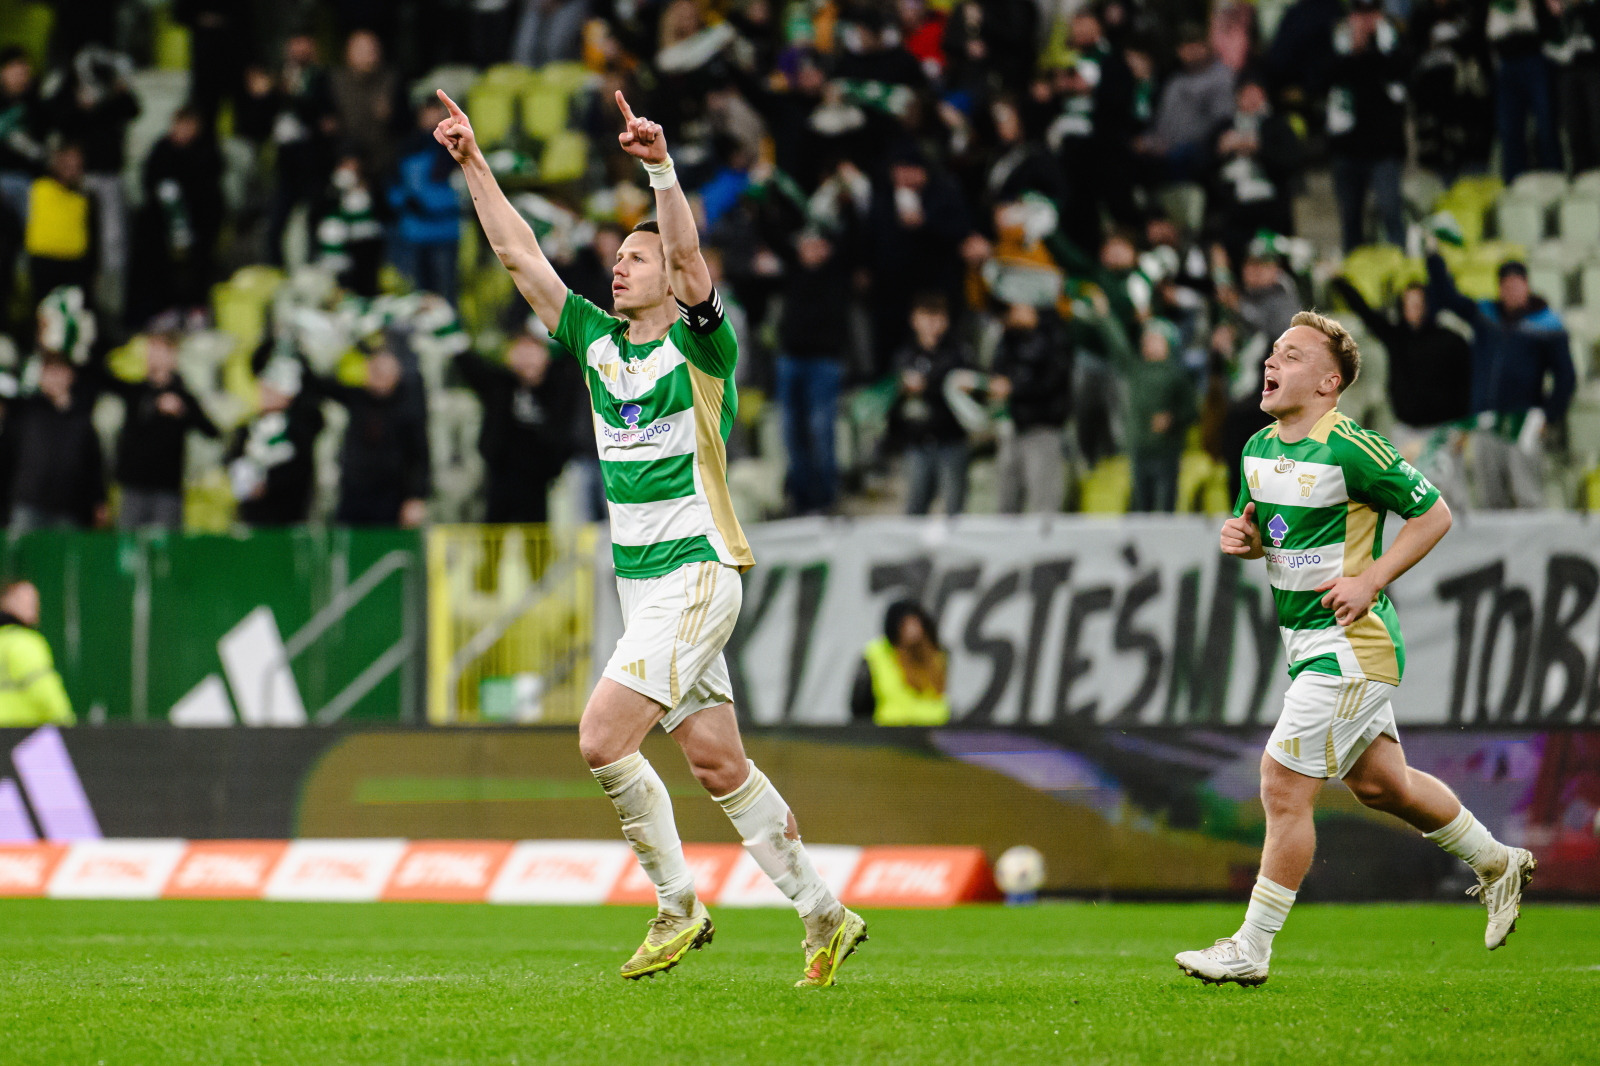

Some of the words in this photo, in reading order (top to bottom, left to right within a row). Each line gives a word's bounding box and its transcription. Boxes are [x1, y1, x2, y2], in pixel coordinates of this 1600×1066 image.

[1301, 485, 1311, 498] 80
[1265, 550, 1321, 569] dacrypto
[1436, 552, 1600, 723] TOB
